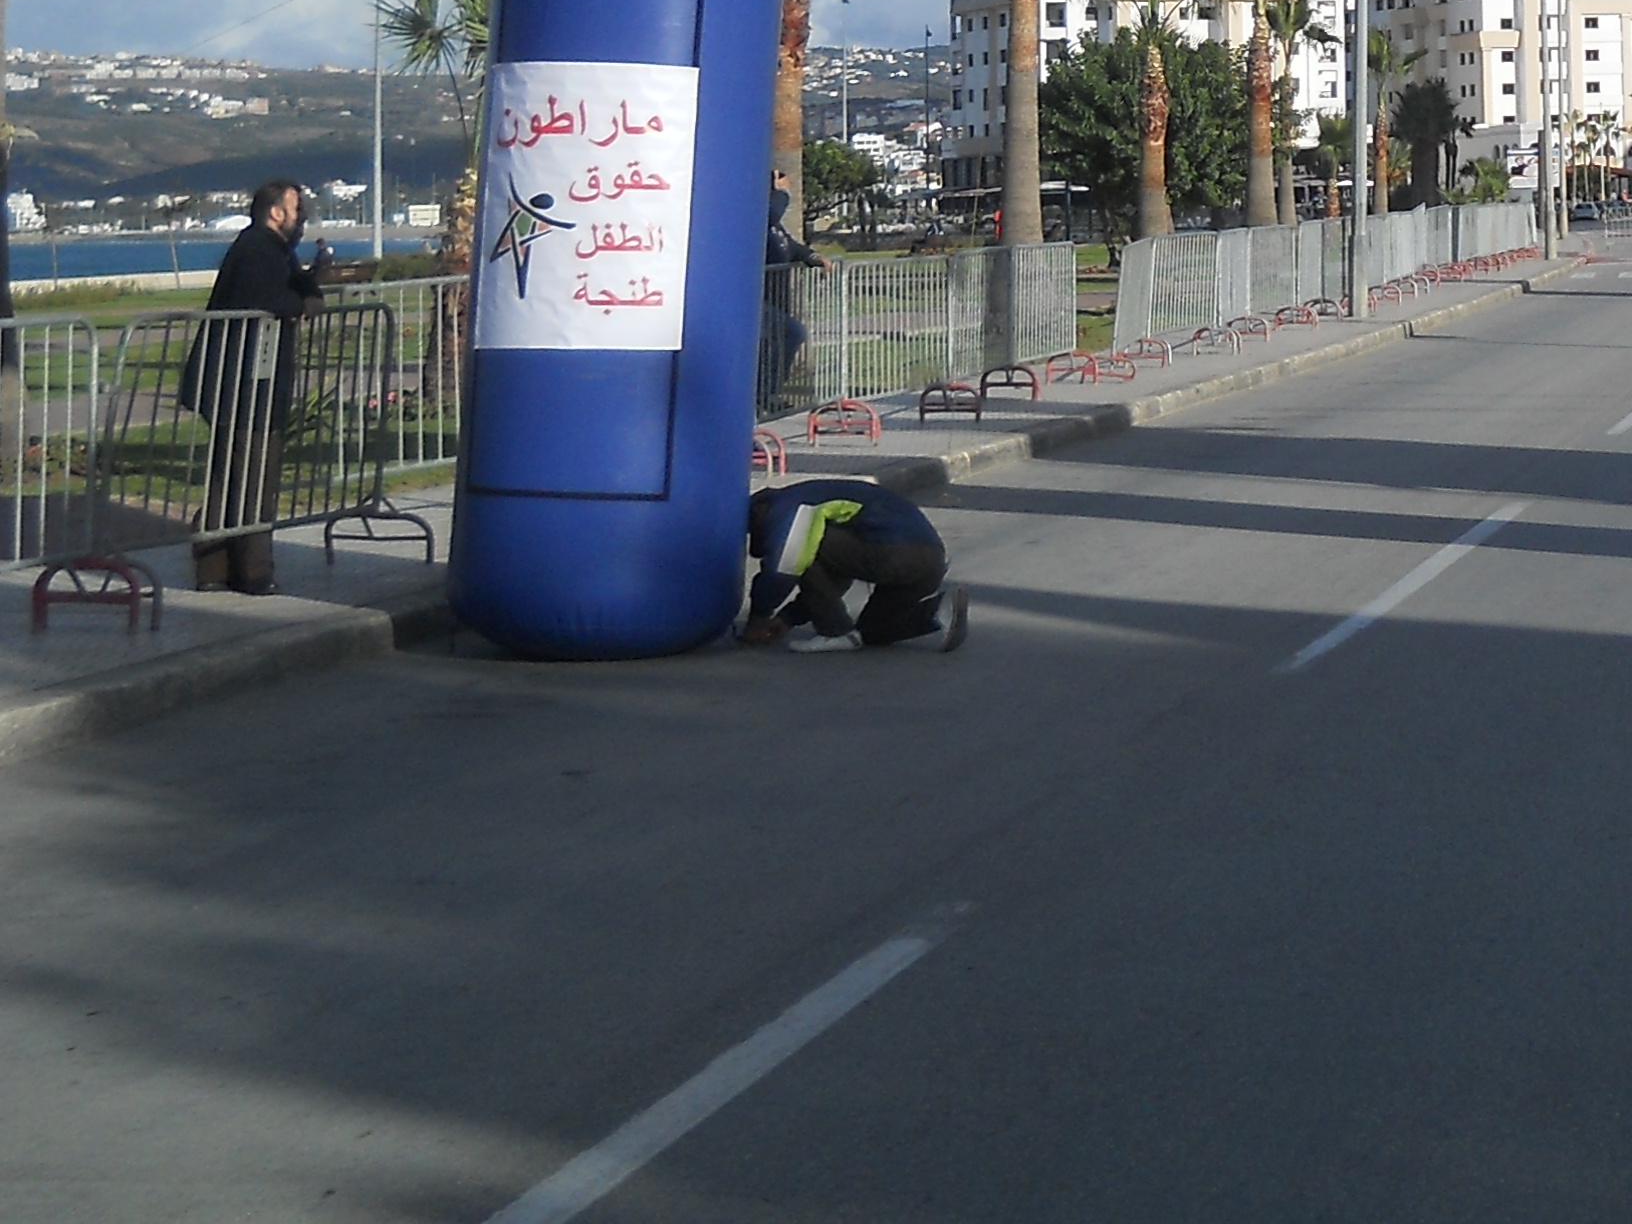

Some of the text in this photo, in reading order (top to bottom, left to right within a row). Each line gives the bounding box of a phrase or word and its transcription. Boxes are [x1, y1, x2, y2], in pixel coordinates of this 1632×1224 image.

[497, 94, 664, 148] ماراطون
[568, 160, 670, 202] حقوق
[575, 222, 662, 260] الطفل
[573, 272, 664, 316] طنجة
